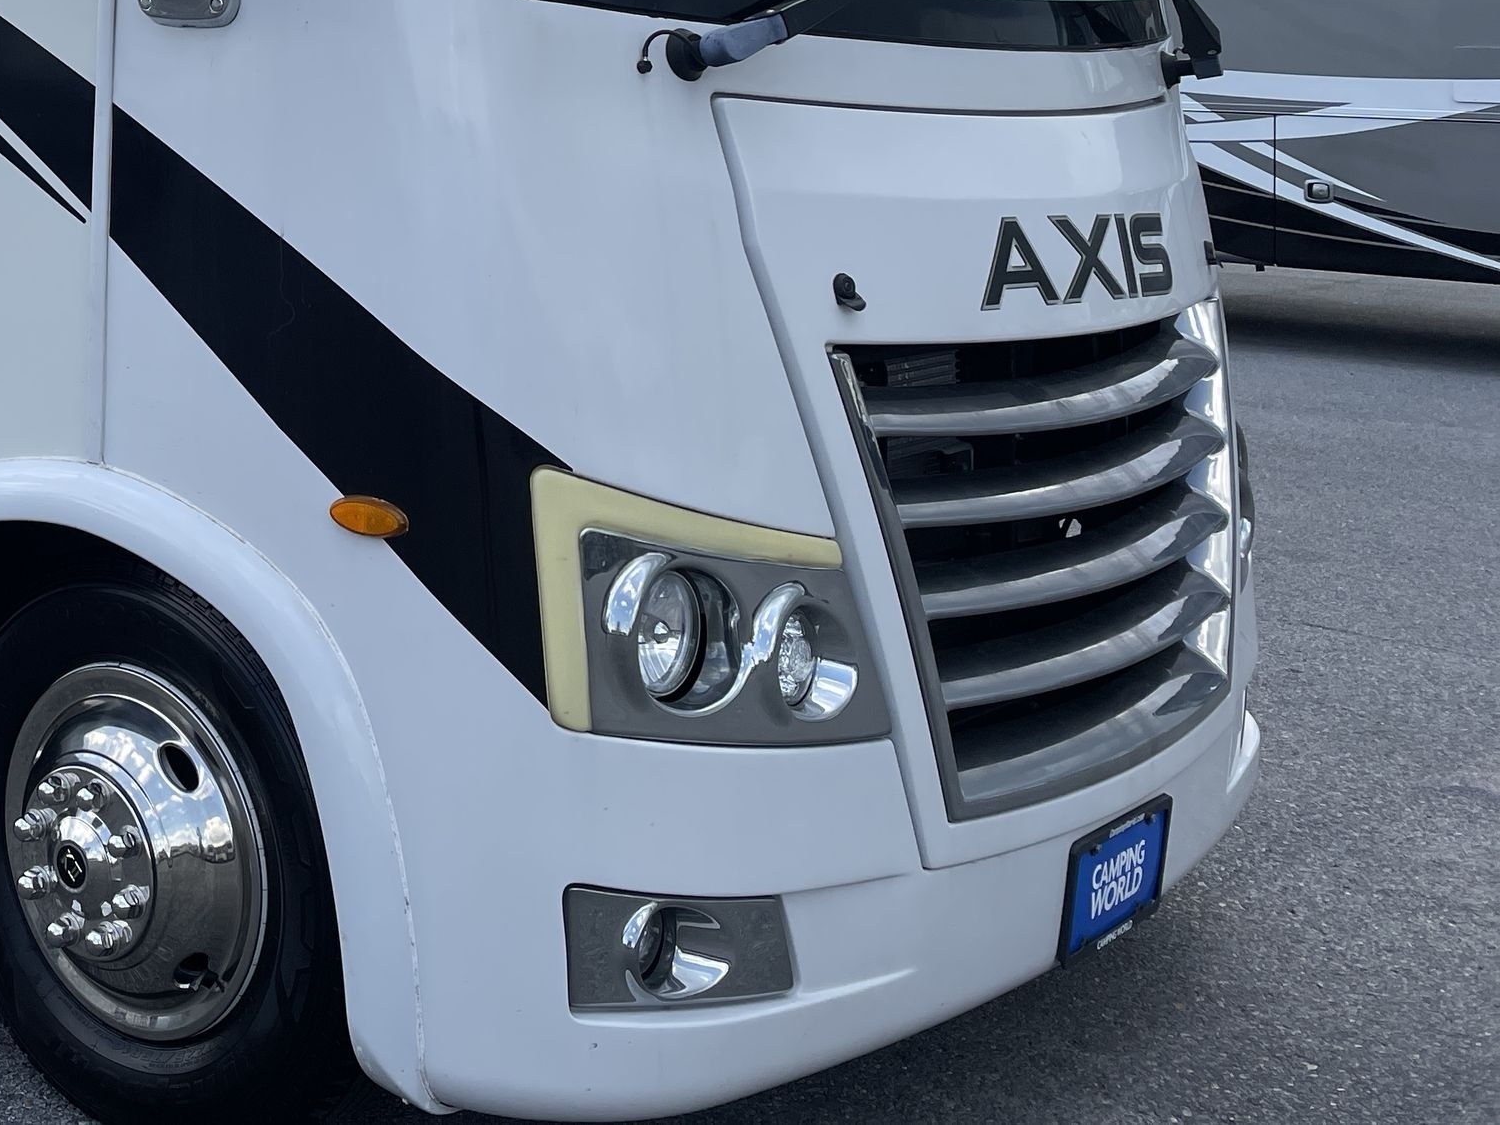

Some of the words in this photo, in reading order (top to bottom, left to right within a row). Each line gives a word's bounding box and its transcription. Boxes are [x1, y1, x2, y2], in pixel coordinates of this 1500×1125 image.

[981, 213, 1173, 311] AXIS
[1092, 839, 1146, 890] CAMPING
[1091, 866, 1143, 920] WORLD
